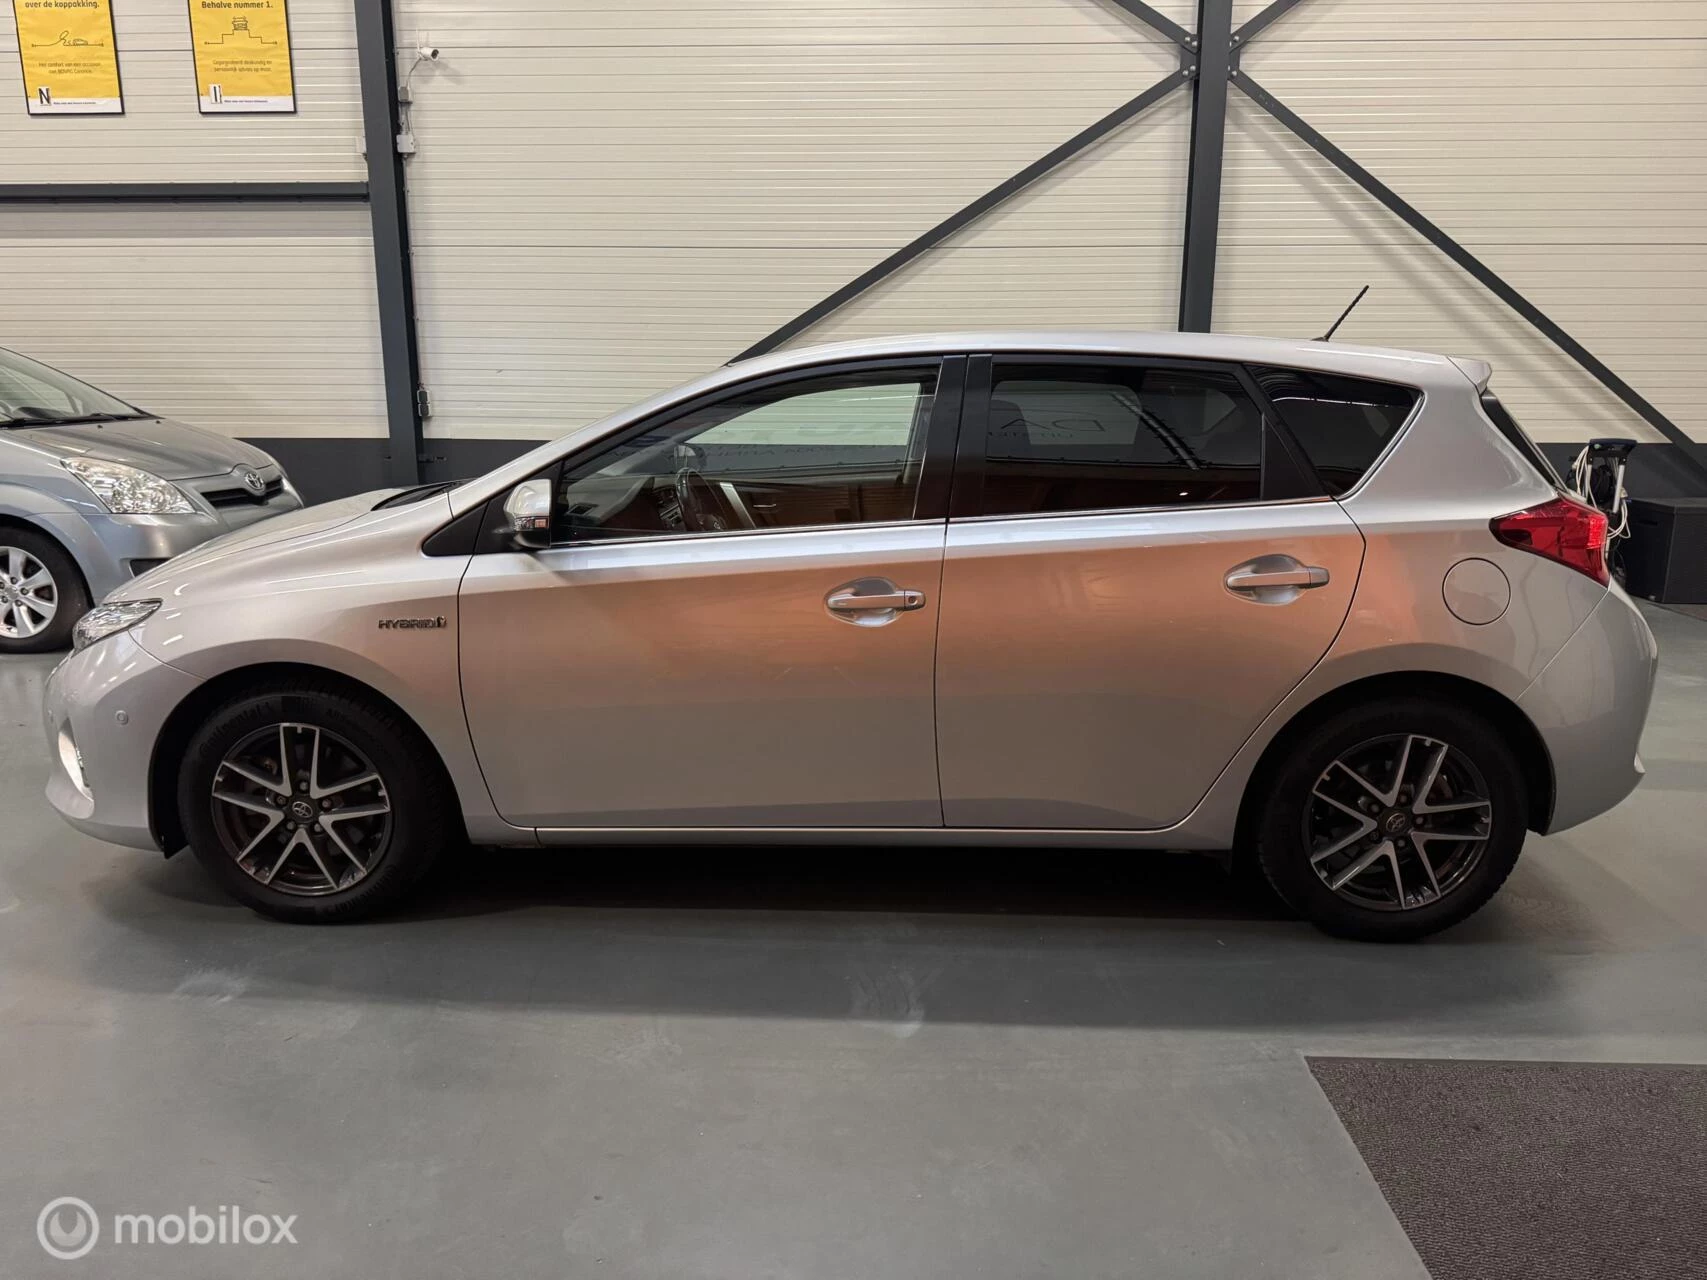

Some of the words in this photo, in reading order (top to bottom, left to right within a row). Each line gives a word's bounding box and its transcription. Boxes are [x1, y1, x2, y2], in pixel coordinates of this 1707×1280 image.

[43, 0, 52, 8] de
[54, 0, 99, 9] koppakking.
[201, 1, 232, 9] Behalve
[265, 1, 274, 9] 1.
[378, 619, 436, 629] HYBRID
